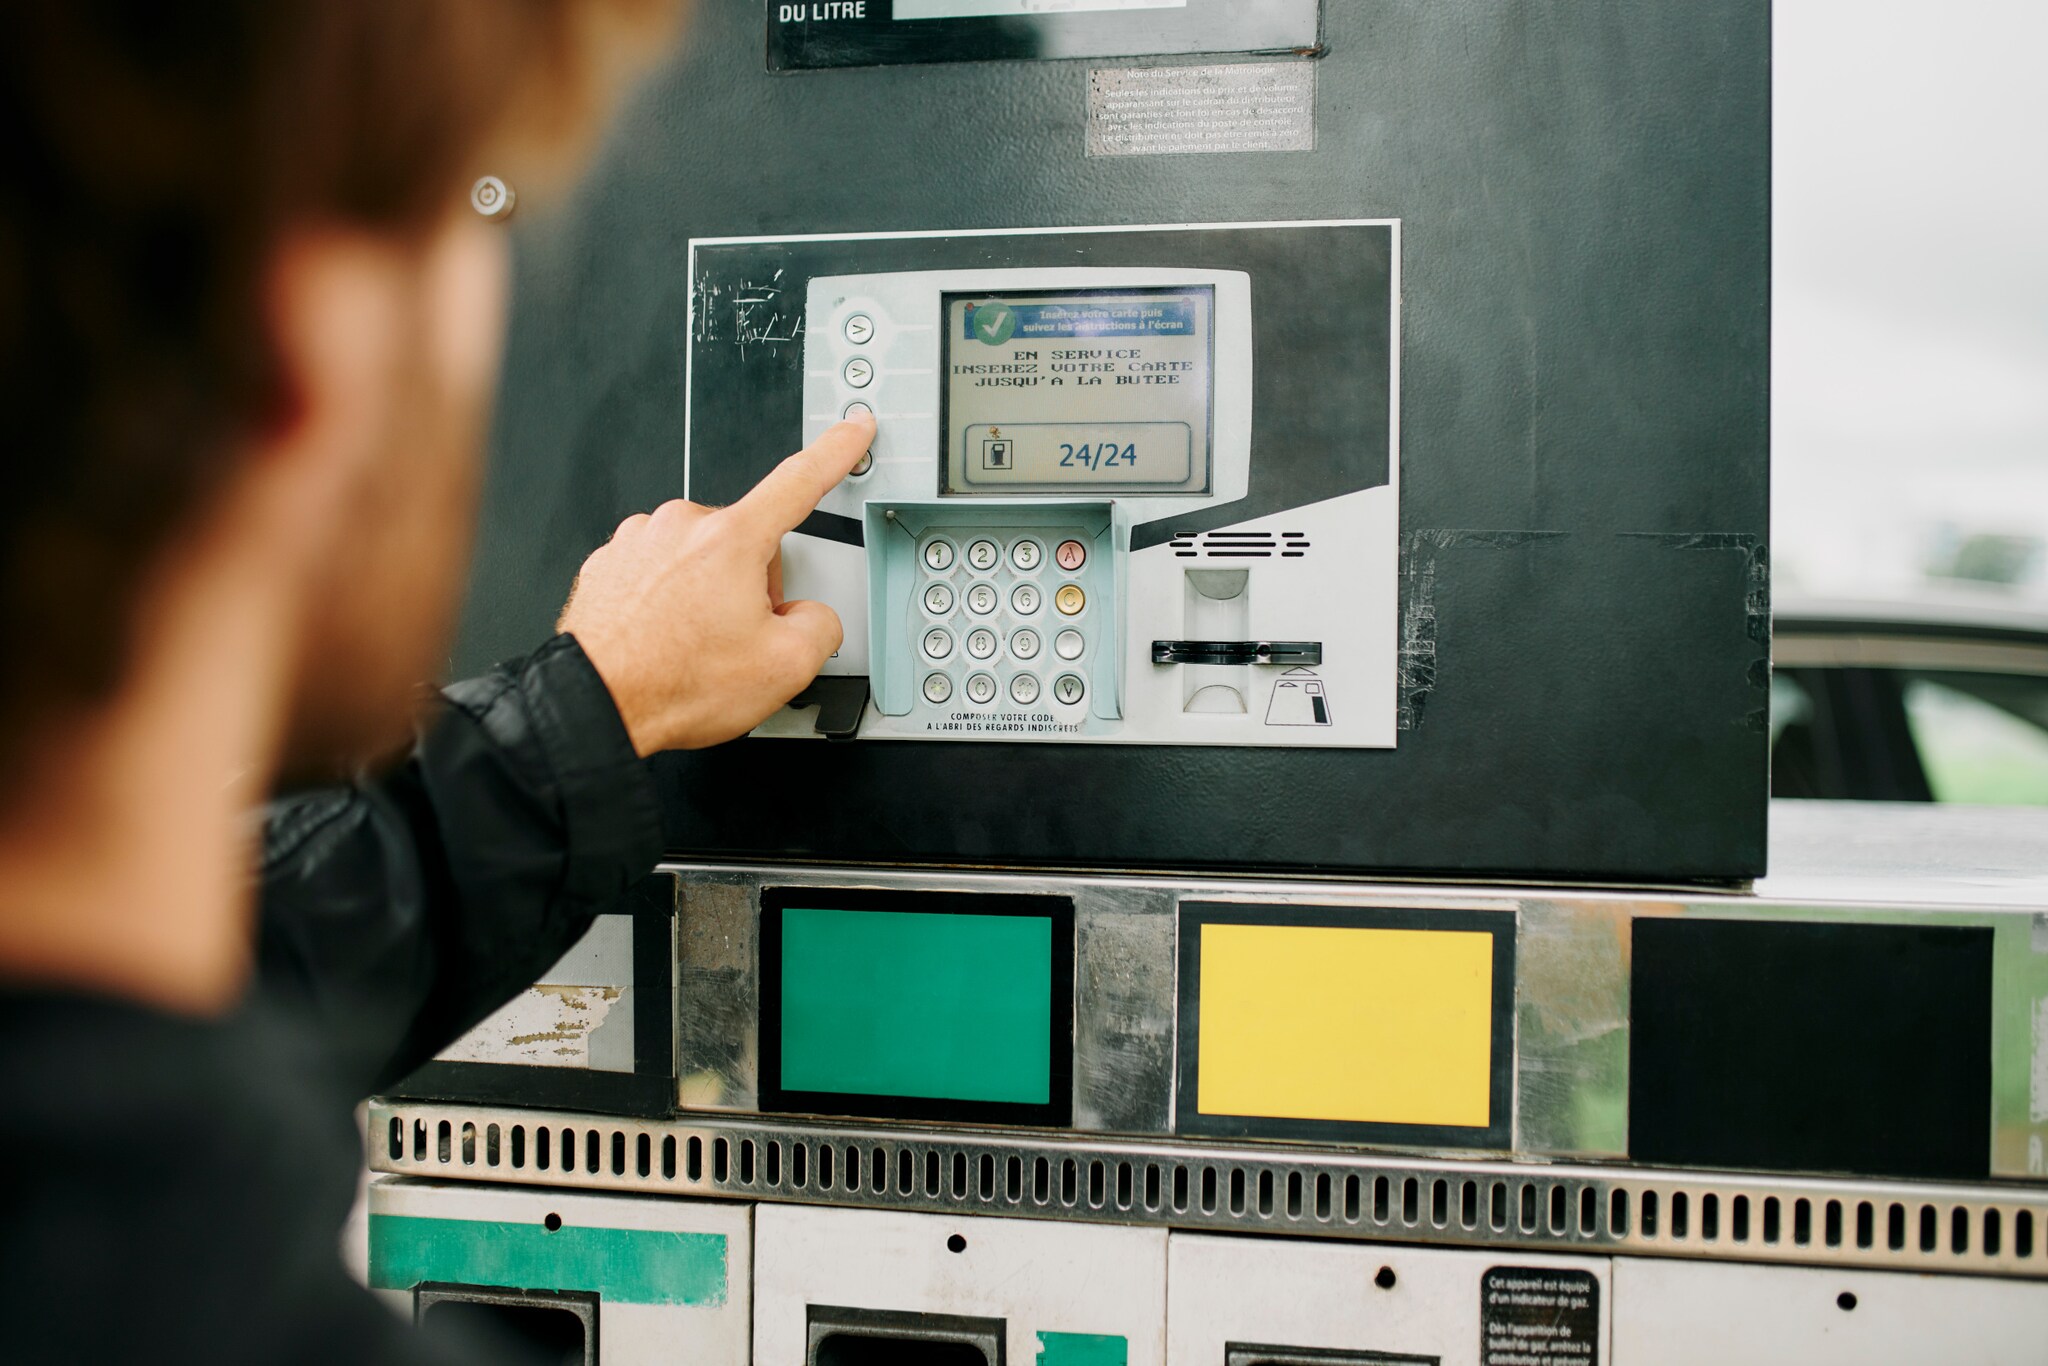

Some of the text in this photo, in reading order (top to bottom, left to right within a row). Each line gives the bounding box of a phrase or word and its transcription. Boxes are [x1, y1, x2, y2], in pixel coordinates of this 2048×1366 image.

[780, 1, 866, 23] DU LITRE
[1127, 70, 1149, 79] Note
[1150, 69, 1164, 78] du
[1165, 68, 1199, 78] Service
[1201, 67, 1213, 76] de
[1214, 67, 1223, 75] la
[1105, 83, 1298, 98] Seules les indications du prix et de volume
[1106, 94, 1297, 110] apparaissant sur le cadran du distributeur
[1099, 111, 1120, 121] sont
[1120, 110, 1163, 121] garanties
[1164, 110, 1174, 119] et
[1176, 108, 1196, 118] font
[1197, 107, 1208, 118] foi
[1211, 108, 1224, 117] en
[1225, 108, 1241, 116] cas
[1242, 106, 1255, 116] de
[1107, 123, 1128, 132] avec
[1130, 121, 1143, 131] les
[1144, 120, 1195, 131] indications
[1197, 119, 1210, 128] du
[1211, 119, 1238, 129] poste
[1240, 118, 1252, 127] de
[1102, 134, 1114, 143] Le
[1114, 132, 1169, 142] distributeur
[1170, 132, 1182, 141] ne
[1184, 130, 1203, 140] doit
[1204, 130, 1222, 141] pas
[1244, 129, 1271, 138] remis
[1130, 144, 1157, 153] avant
[1158, 142, 1167, 152] le
[1168, 142, 1212, 152] paiement
[1214, 142, 1228, 152] par
[1231, 141, 1241, 150] le
[1040, 308, 1163, 320] Insérez votre carte puis
[1023, 322, 1056, 332] suivez
[1057, 321, 1073, 331] les
[1139, 319, 1146, 330] à
[1147, 319, 1184, 330] l'écran
[1014, 349, 1141, 361] EN SERVICE
[953, 361, 1193, 375] INSEREZ VOTRE CARTE
[975, 374, 1180, 388] JUSQU'A LA BUTEE
[1059, 442, 1137, 472] 24/24
[935, 546, 1076, 564] 1 2 3 A
[932, 592, 1076, 608] 4 5 6 C
[932, 636, 1031, 652] 7 8 9
[1063, 682, 1074, 698] V
[950, 712, 1054, 722] COMPOSER VOTRE CODE
[926, 722, 1079, 733] A L'ABRI DES REGARDS INDISCRETS
[1489, 1276, 1590, 1294] Cet appareil est équipé
[1489, 1292, 1590, 1310] d'un indicateur de gaz.
[1489, 1321, 1572, 1338] Dès l'apparition de
[1517, 1339, 1529, 1351] de
[1582, 1341, 1591, 1353] la
[1488, 1354, 1540, 1366] distribution
[1542, 1355, 1551, 1366] et
